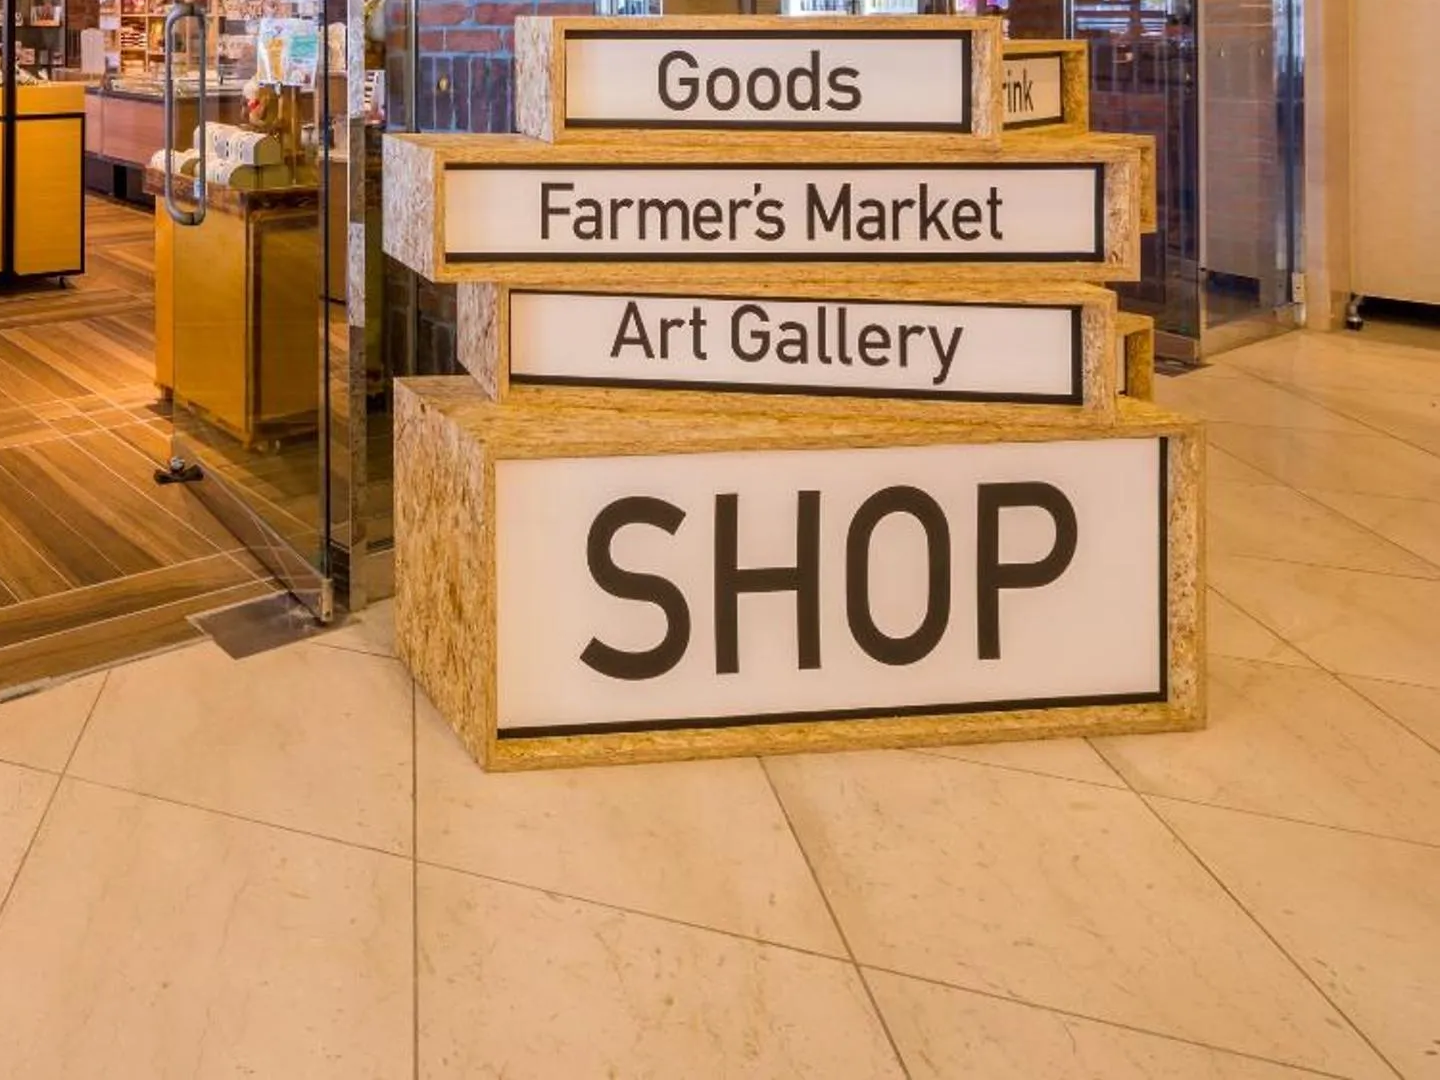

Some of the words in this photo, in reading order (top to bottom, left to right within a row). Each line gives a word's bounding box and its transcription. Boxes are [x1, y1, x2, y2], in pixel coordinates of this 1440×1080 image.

[657, 50, 862, 112] Goods
[539, 182, 786, 241] Farmer's
[805, 183, 1004, 242] Market
[610, 301, 707, 360] Art
[729, 304, 964, 385] Gallery
[578, 480, 1079, 682] SHOP
